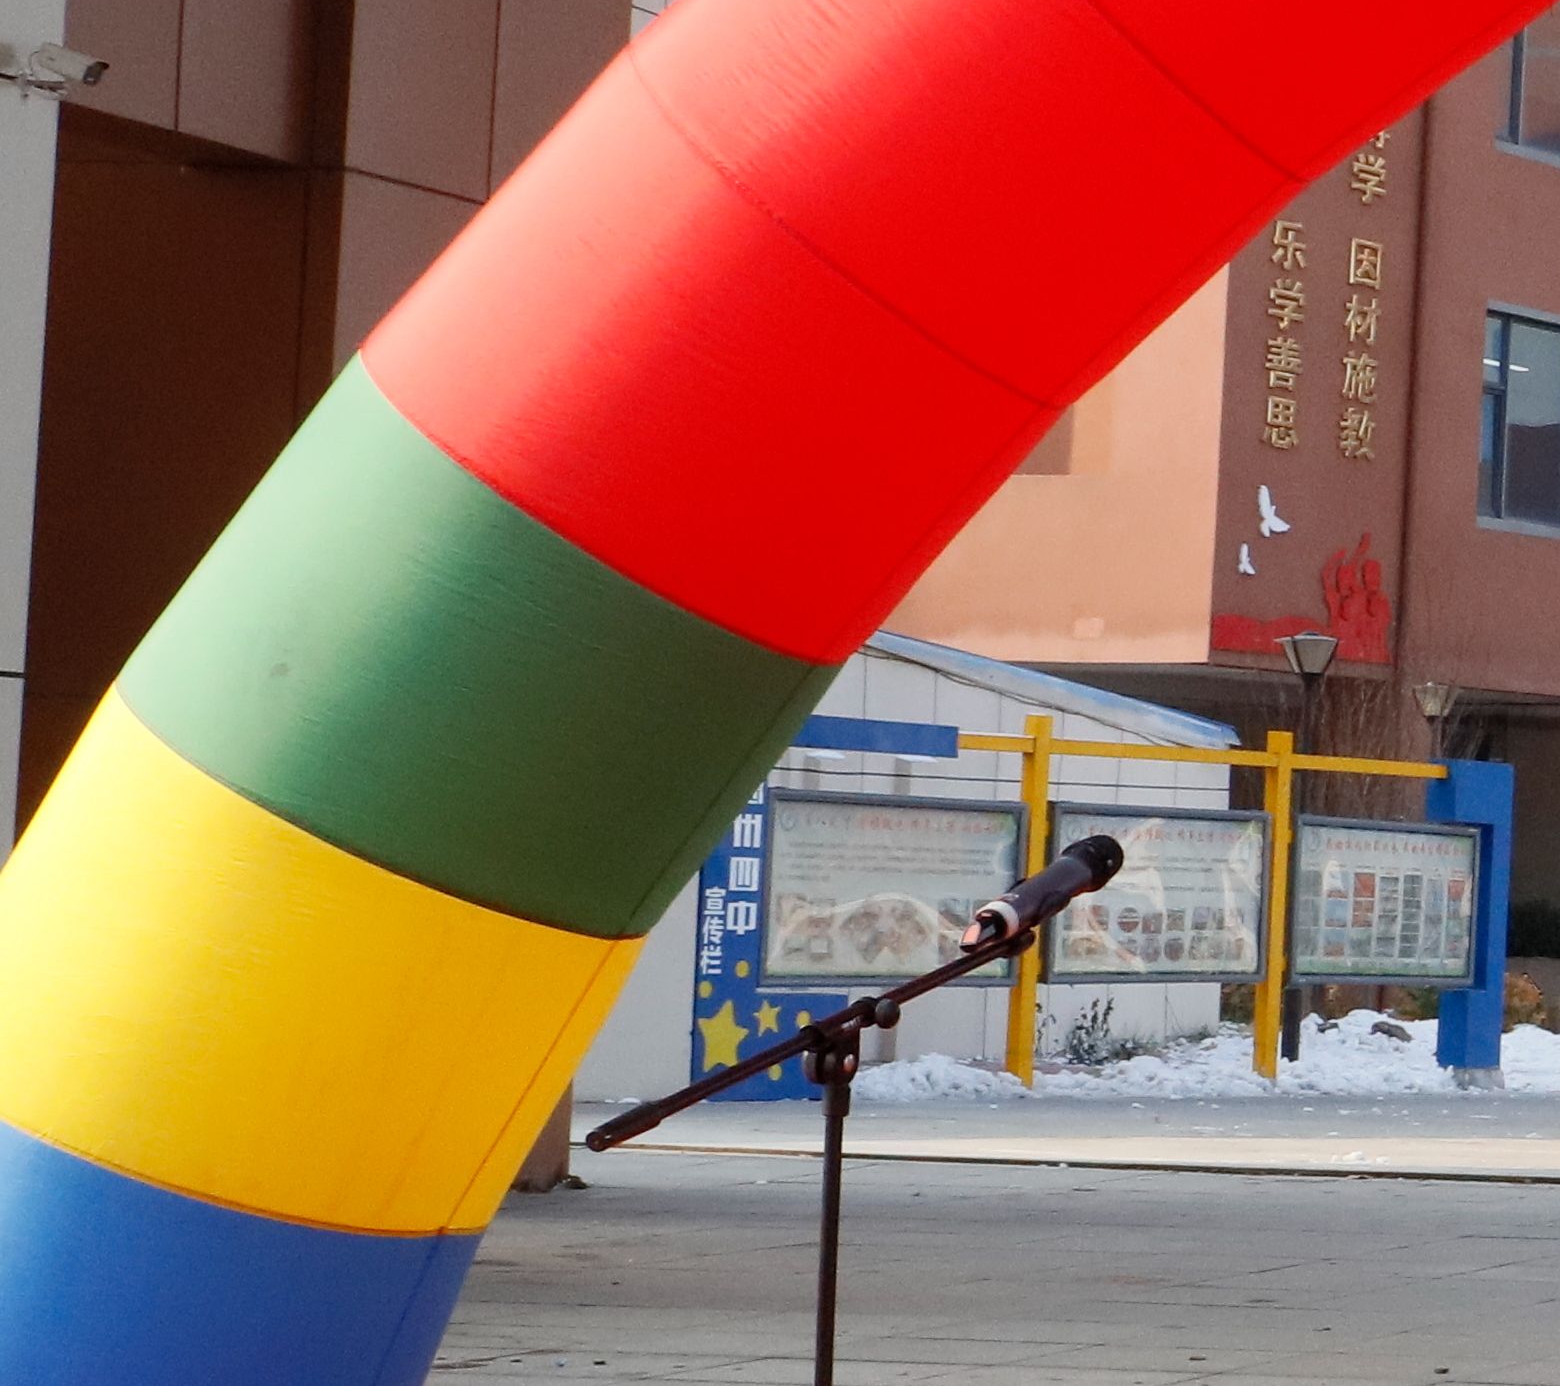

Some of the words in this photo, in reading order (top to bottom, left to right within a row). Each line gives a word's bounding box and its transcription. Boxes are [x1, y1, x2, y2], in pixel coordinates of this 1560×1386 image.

[1262, 219, 1306, 449] 乐学善思
[700, 885, 728, 975] 宣传栏
[727, 782, 765, 935] 州四中
